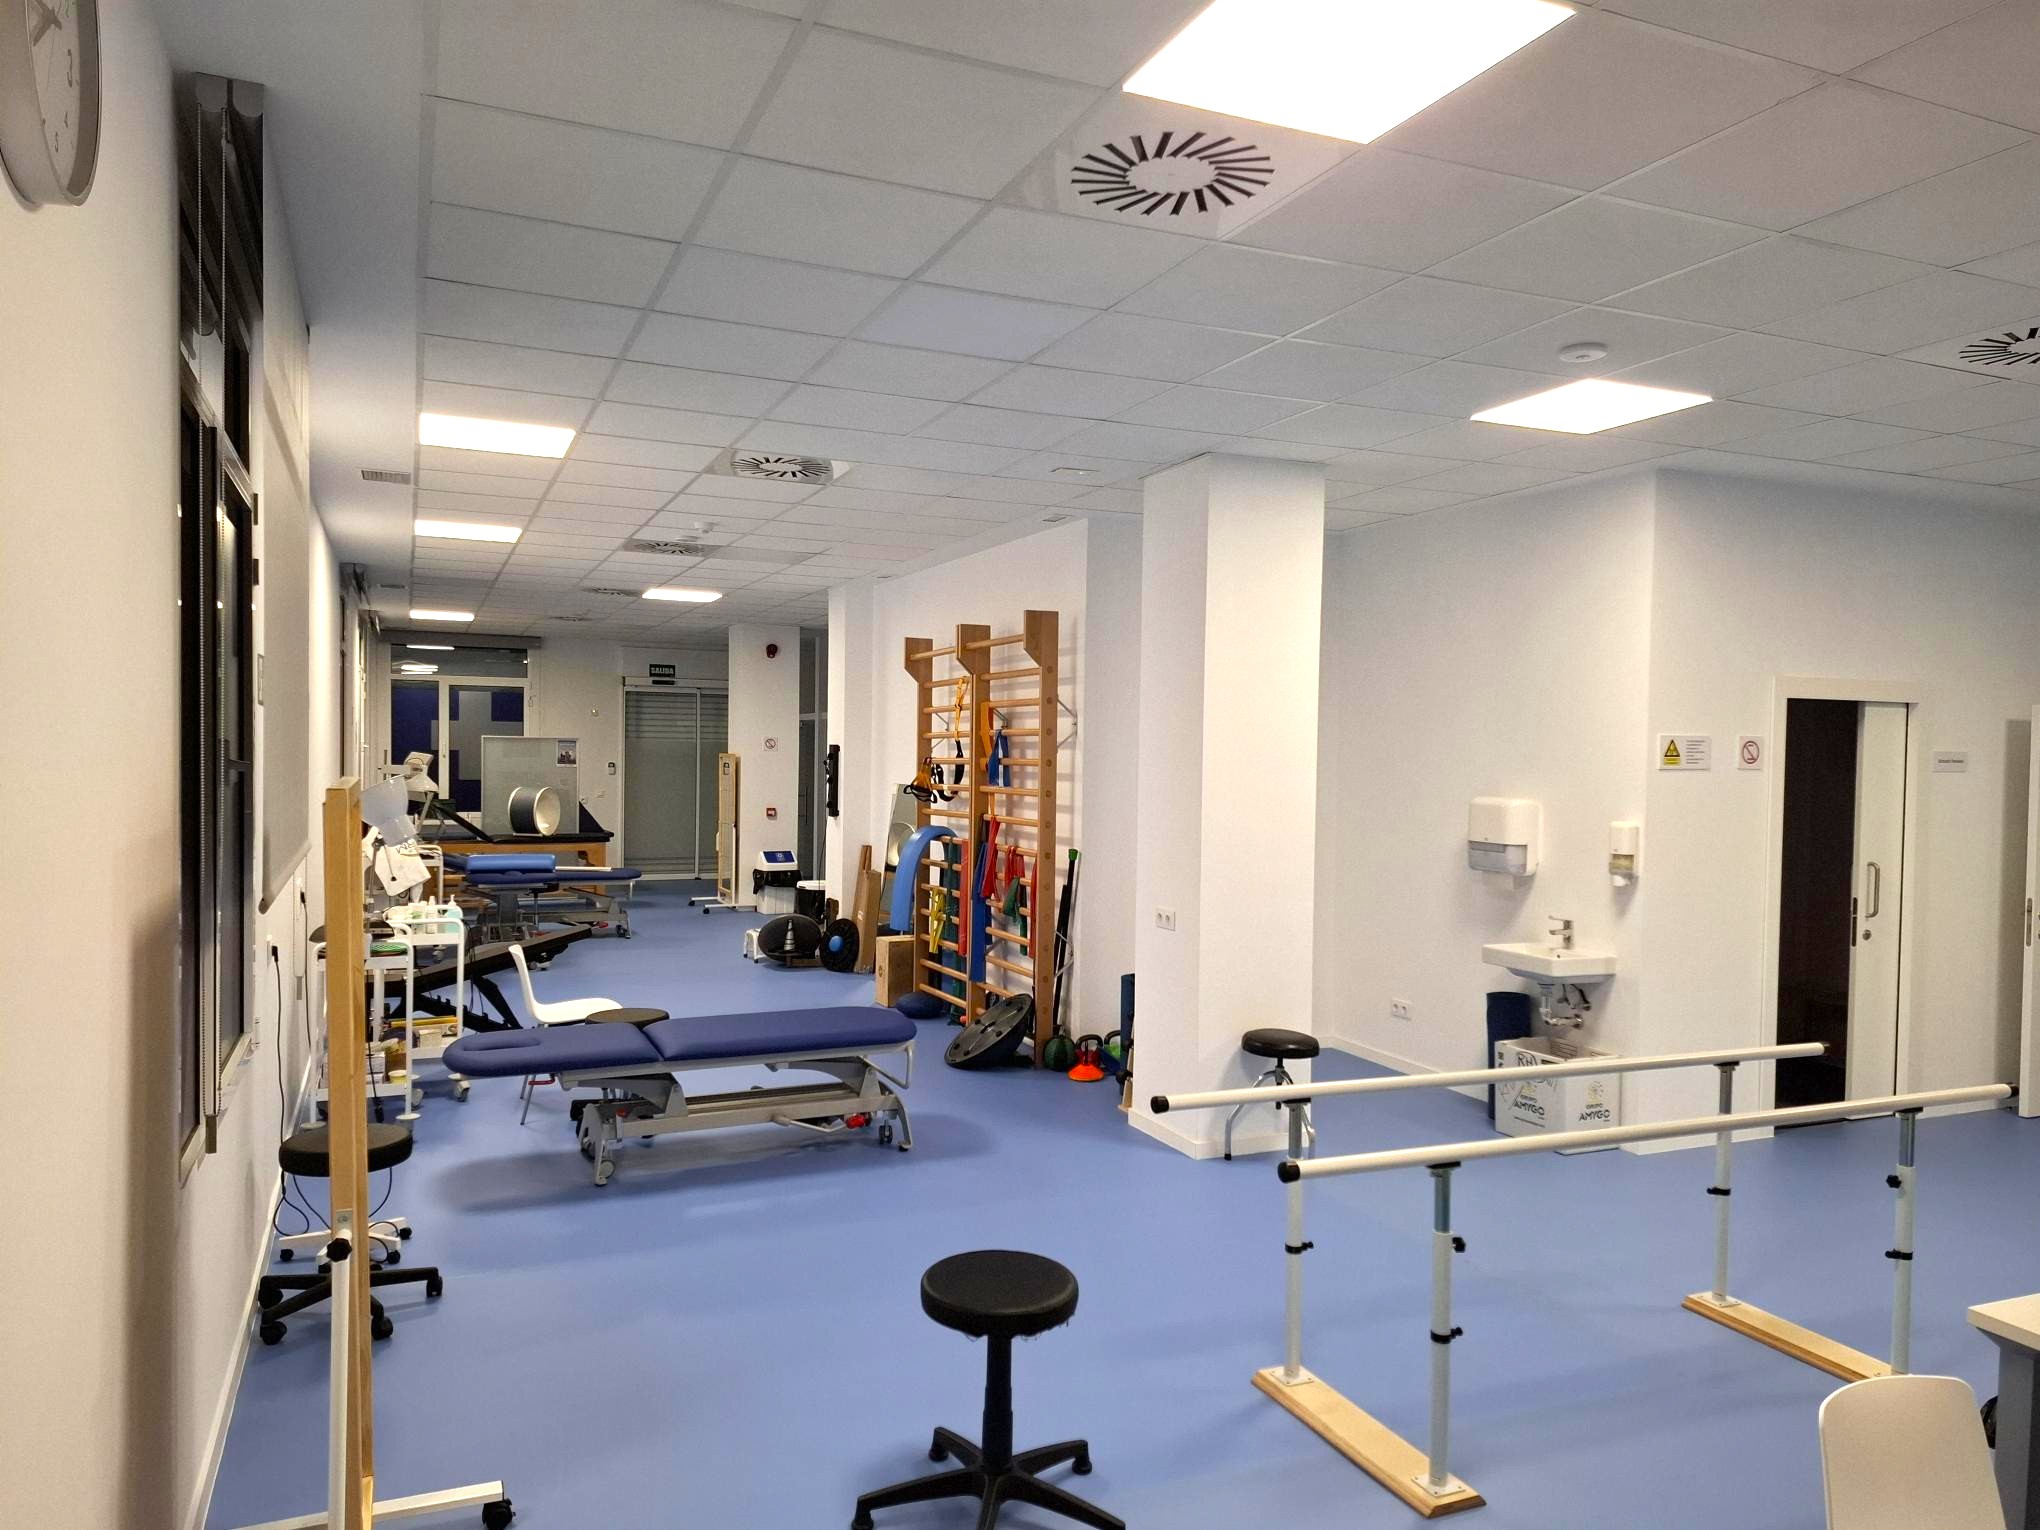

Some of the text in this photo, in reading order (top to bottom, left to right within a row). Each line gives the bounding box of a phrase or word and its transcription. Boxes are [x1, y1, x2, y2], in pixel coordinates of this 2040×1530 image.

[650, 667, 674, 675] SALIDA
[1513, 1100, 1545, 1116] AMYGO
[1578, 1109, 1611, 1121] AMYGO
